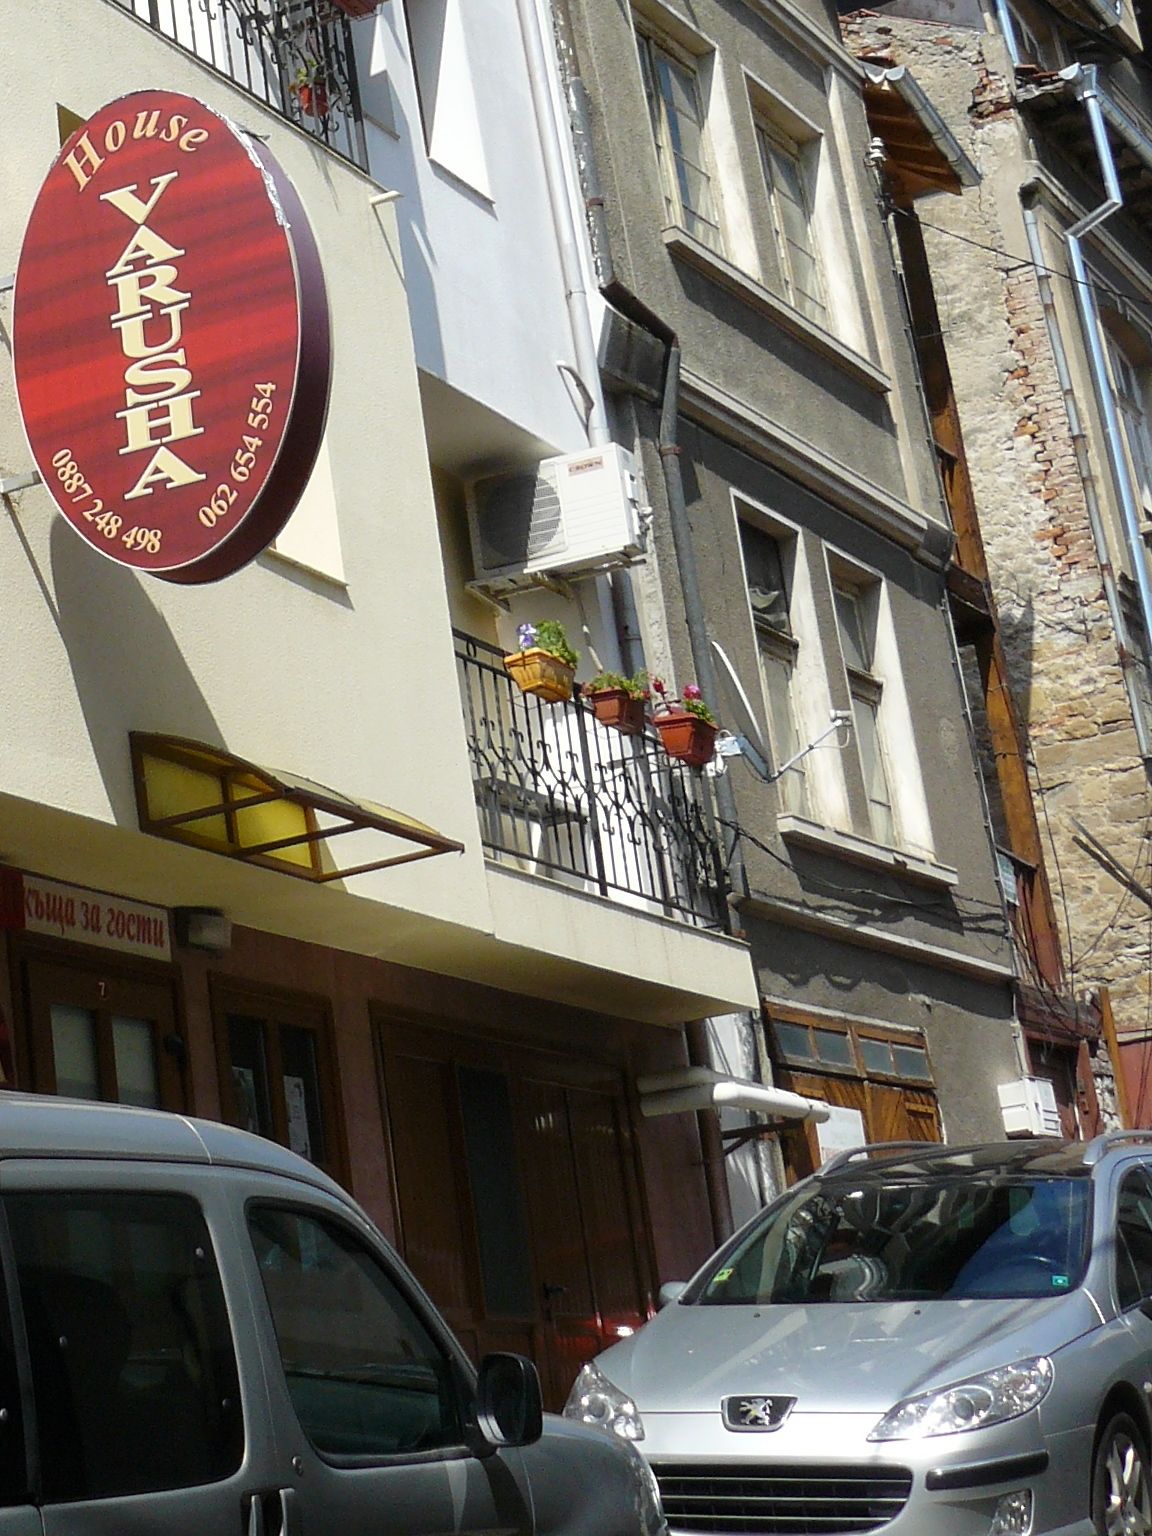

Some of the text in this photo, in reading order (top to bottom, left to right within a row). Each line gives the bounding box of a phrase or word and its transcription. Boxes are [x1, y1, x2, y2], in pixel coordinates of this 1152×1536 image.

[62, 109, 208, 192] House
[99, 170, 206, 501] VARUSHA
[51, 447, 163, 555] 0887 248 498
[198, 381, 277, 529] 062 654 554
[24, 887, 165, 948] къща за гости
[98, 981, 105, 997] 7
